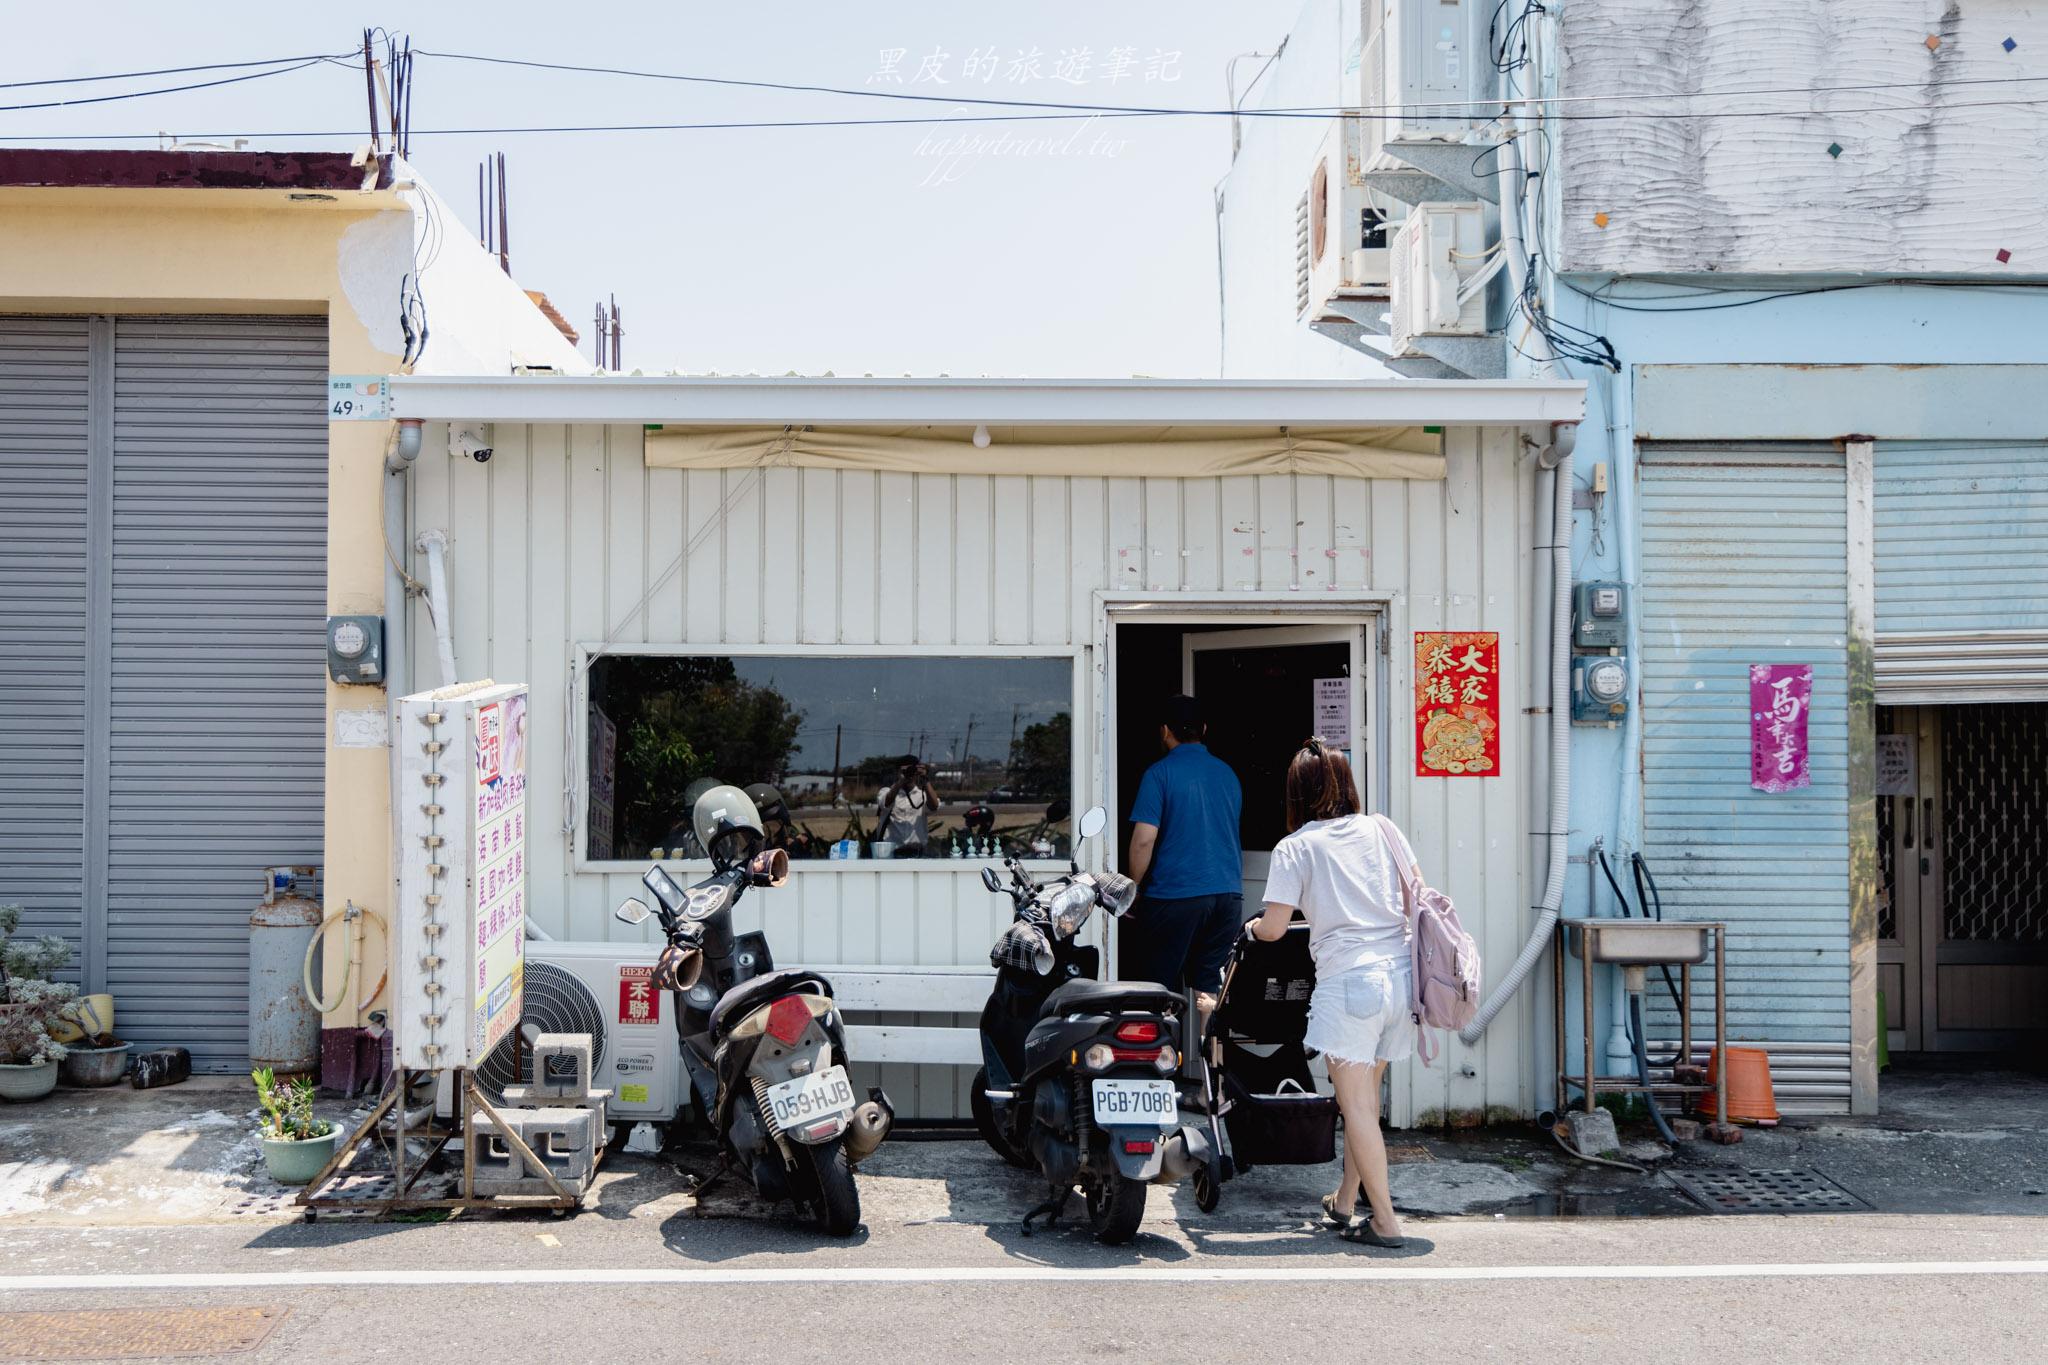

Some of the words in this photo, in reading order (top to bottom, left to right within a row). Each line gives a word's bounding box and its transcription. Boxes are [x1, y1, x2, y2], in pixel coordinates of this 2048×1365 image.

[1424, 644, 1459, 704] 恭禧
[1456, 645, 1489, 704] 大家
[622, 968, 654, 976] HERA
[629, 982, 650, 1018] 禾聯
